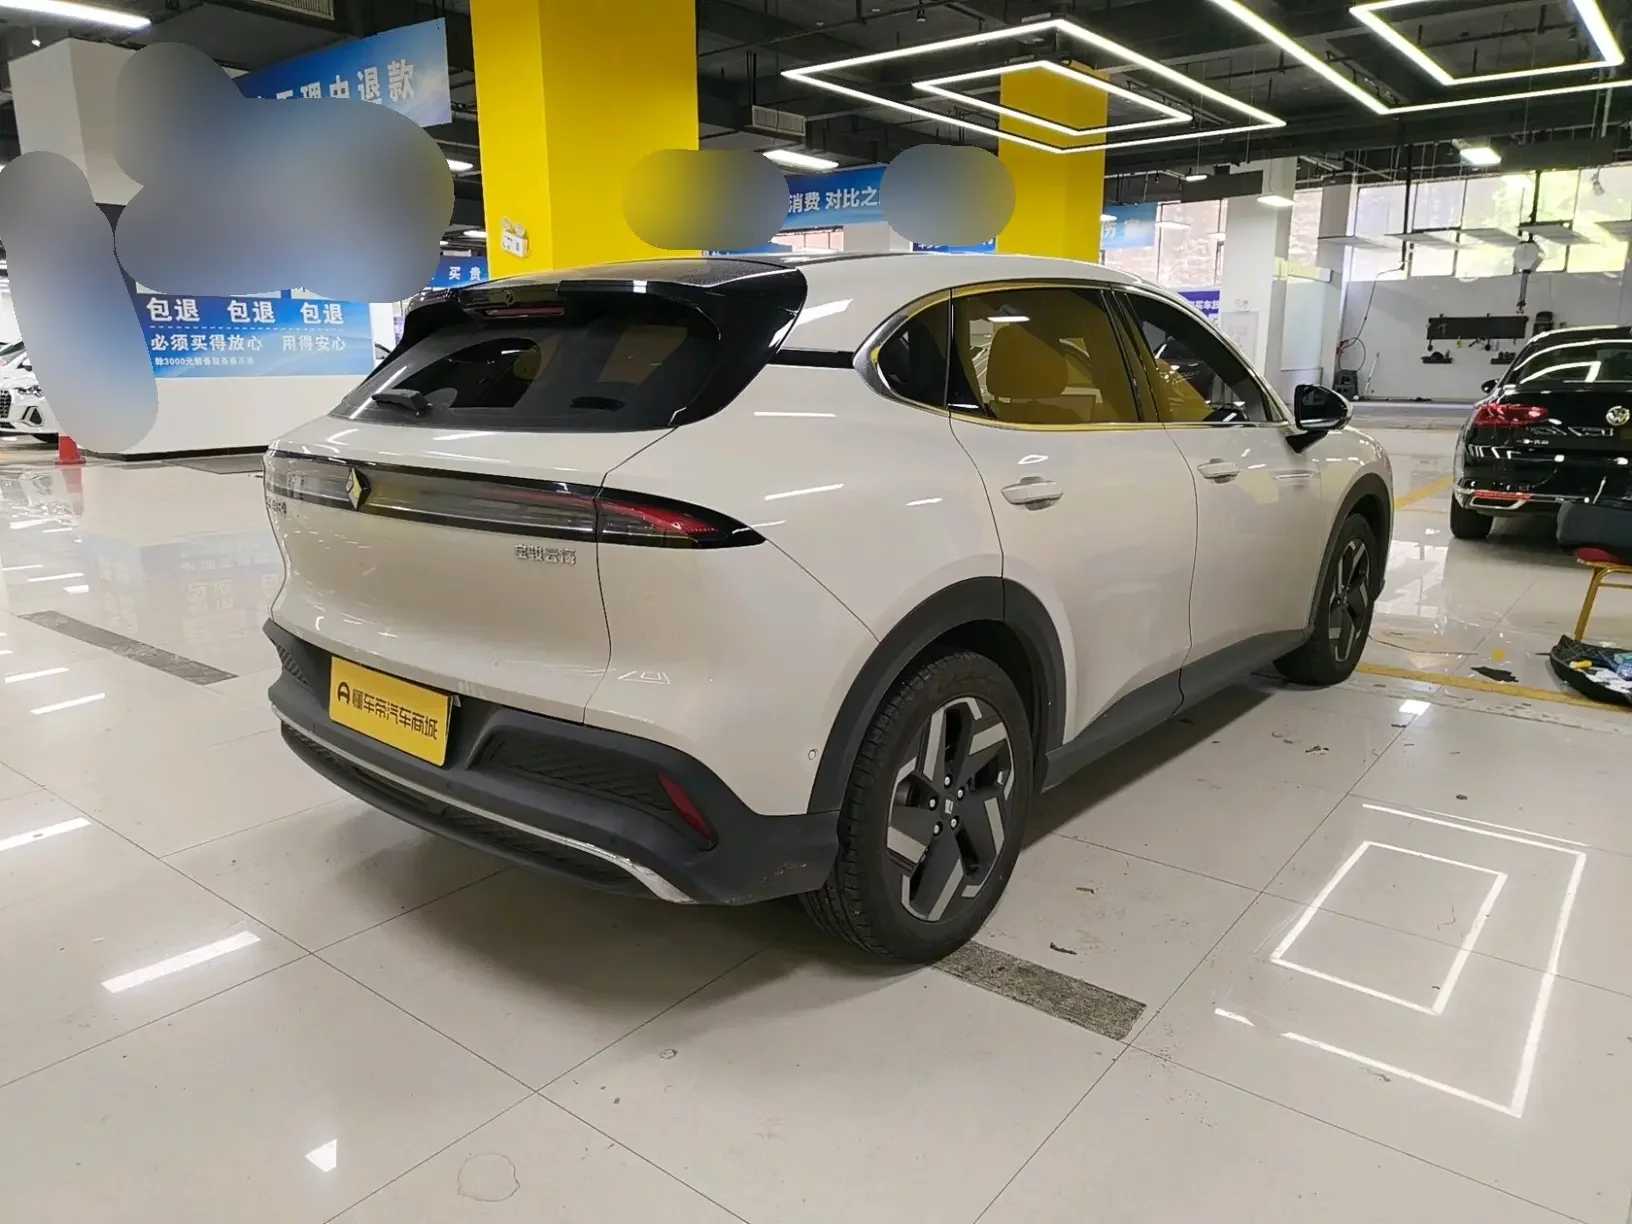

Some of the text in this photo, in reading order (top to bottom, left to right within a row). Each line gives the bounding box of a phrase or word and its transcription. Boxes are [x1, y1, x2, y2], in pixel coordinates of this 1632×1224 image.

[275, 59, 415, 104] 理由退款
[788, 186, 880, 213] 消费 对比之
[147, 297, 344, 325] 包退 包退 包退
[151, 334, 346, 351] 必须买得放心 用得安心
[352, 688, 437, 740] 懂车帝汽车商城
